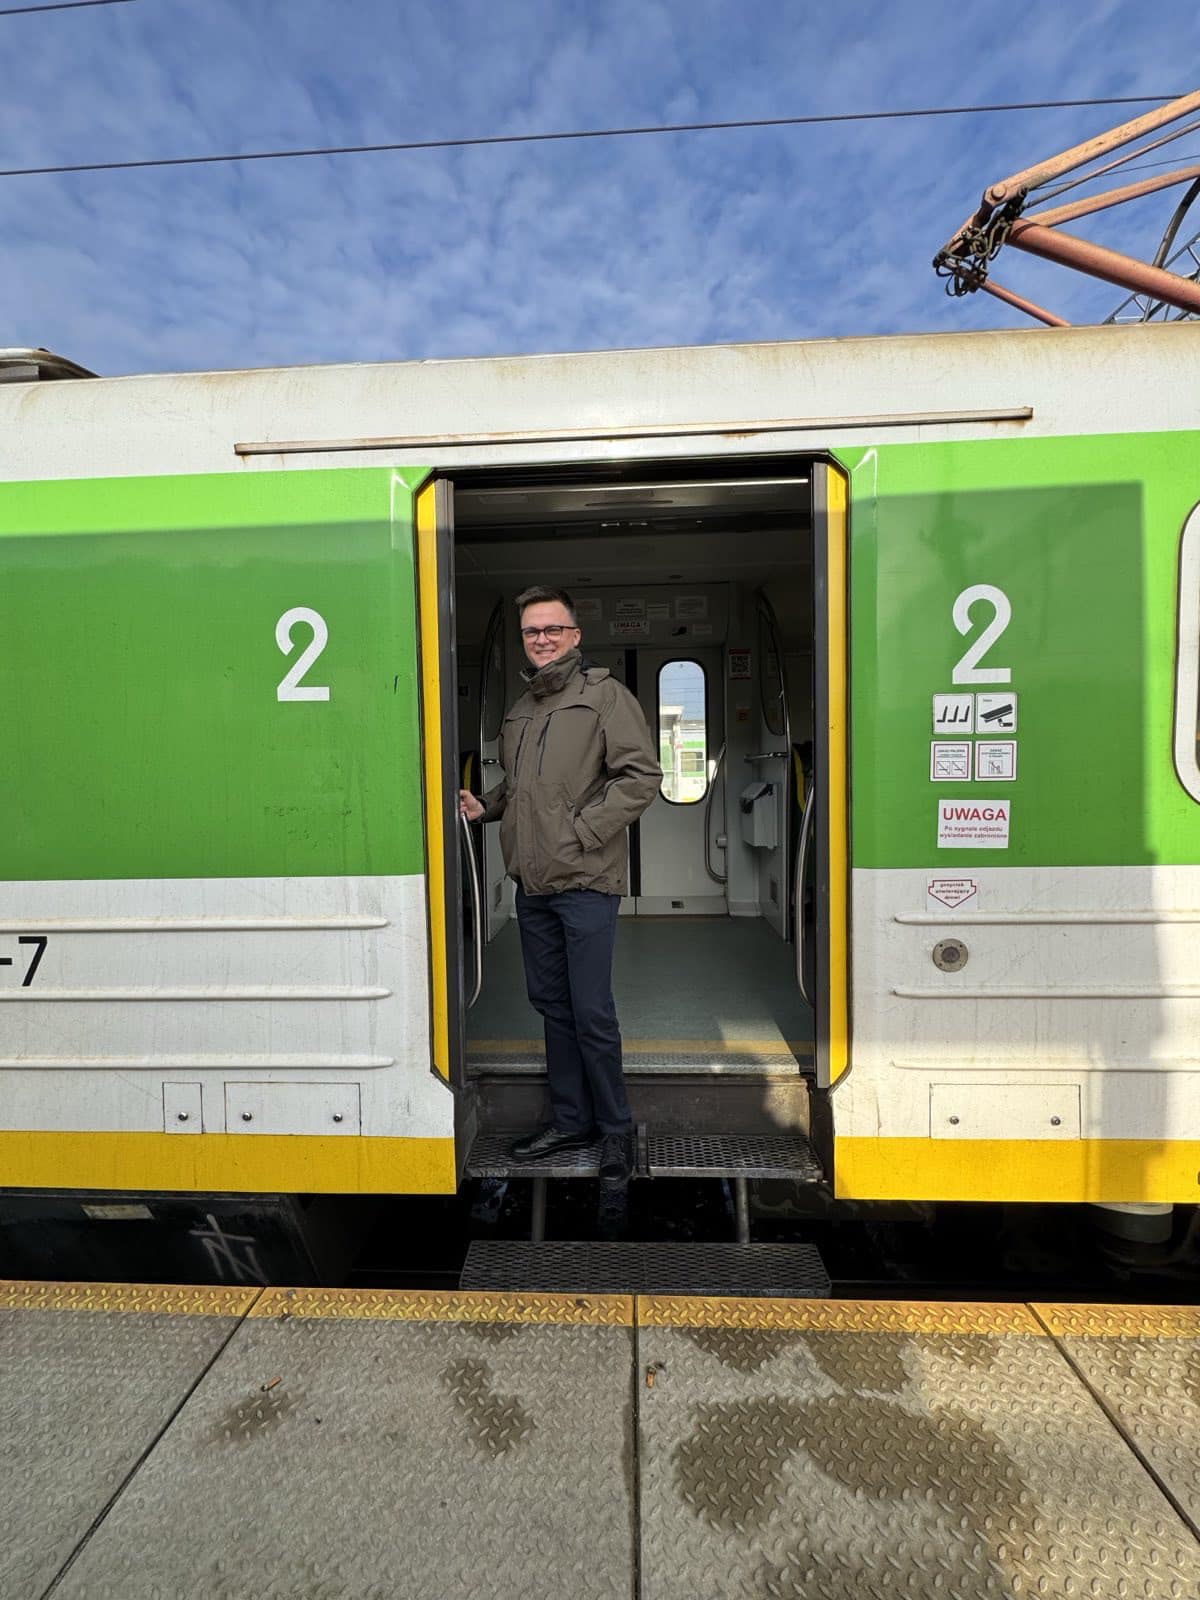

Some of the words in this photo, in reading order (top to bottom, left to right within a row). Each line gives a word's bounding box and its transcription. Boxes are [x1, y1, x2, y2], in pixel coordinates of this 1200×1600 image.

[276, 607, 330, 701] 2
[952, 584, 1011, 684] 2
[943, 808, 1007, 821] UWAGA
